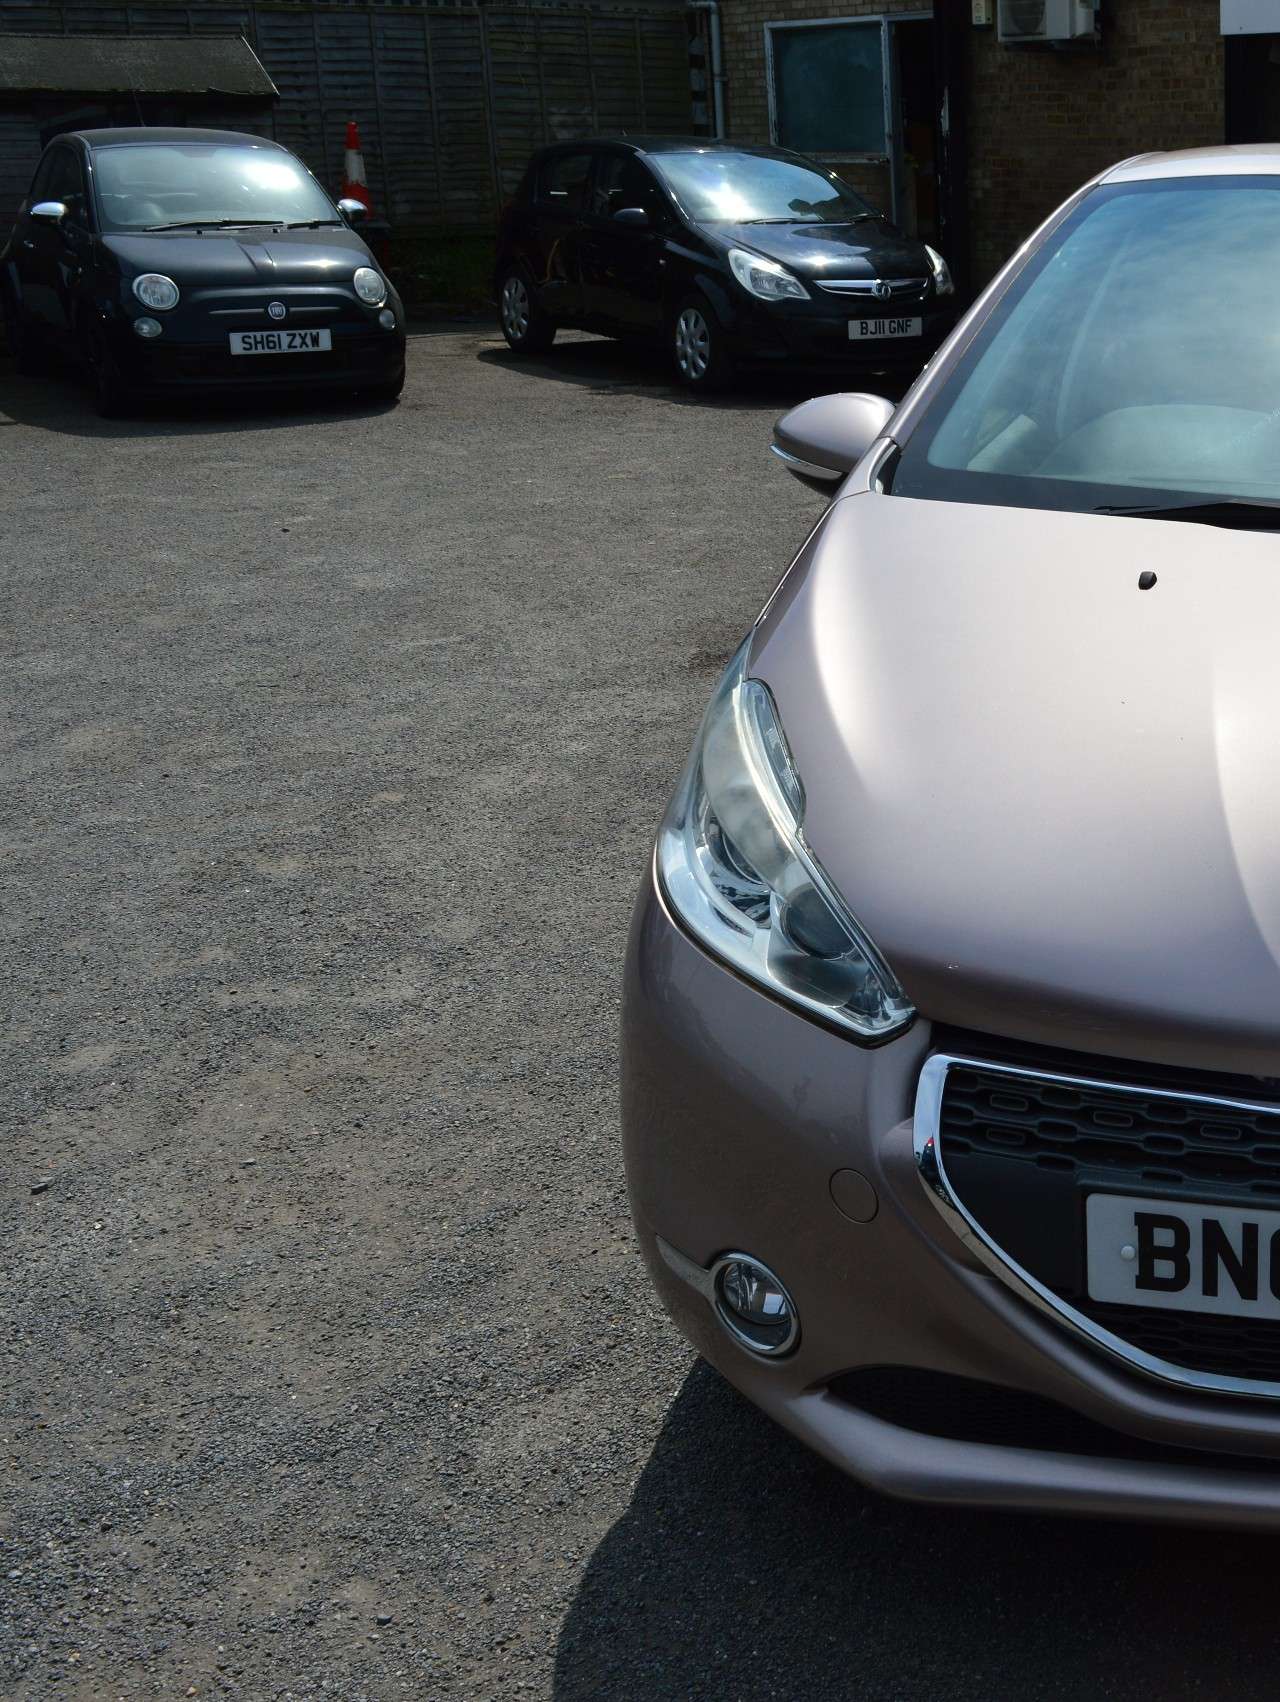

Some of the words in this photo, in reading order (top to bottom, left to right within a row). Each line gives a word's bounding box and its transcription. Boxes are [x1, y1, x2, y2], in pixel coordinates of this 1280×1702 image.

[889, 319, 912, 334] GNF
[241, 334, 282, 351] SH61
[286, 332, 320, 349] ZXW
